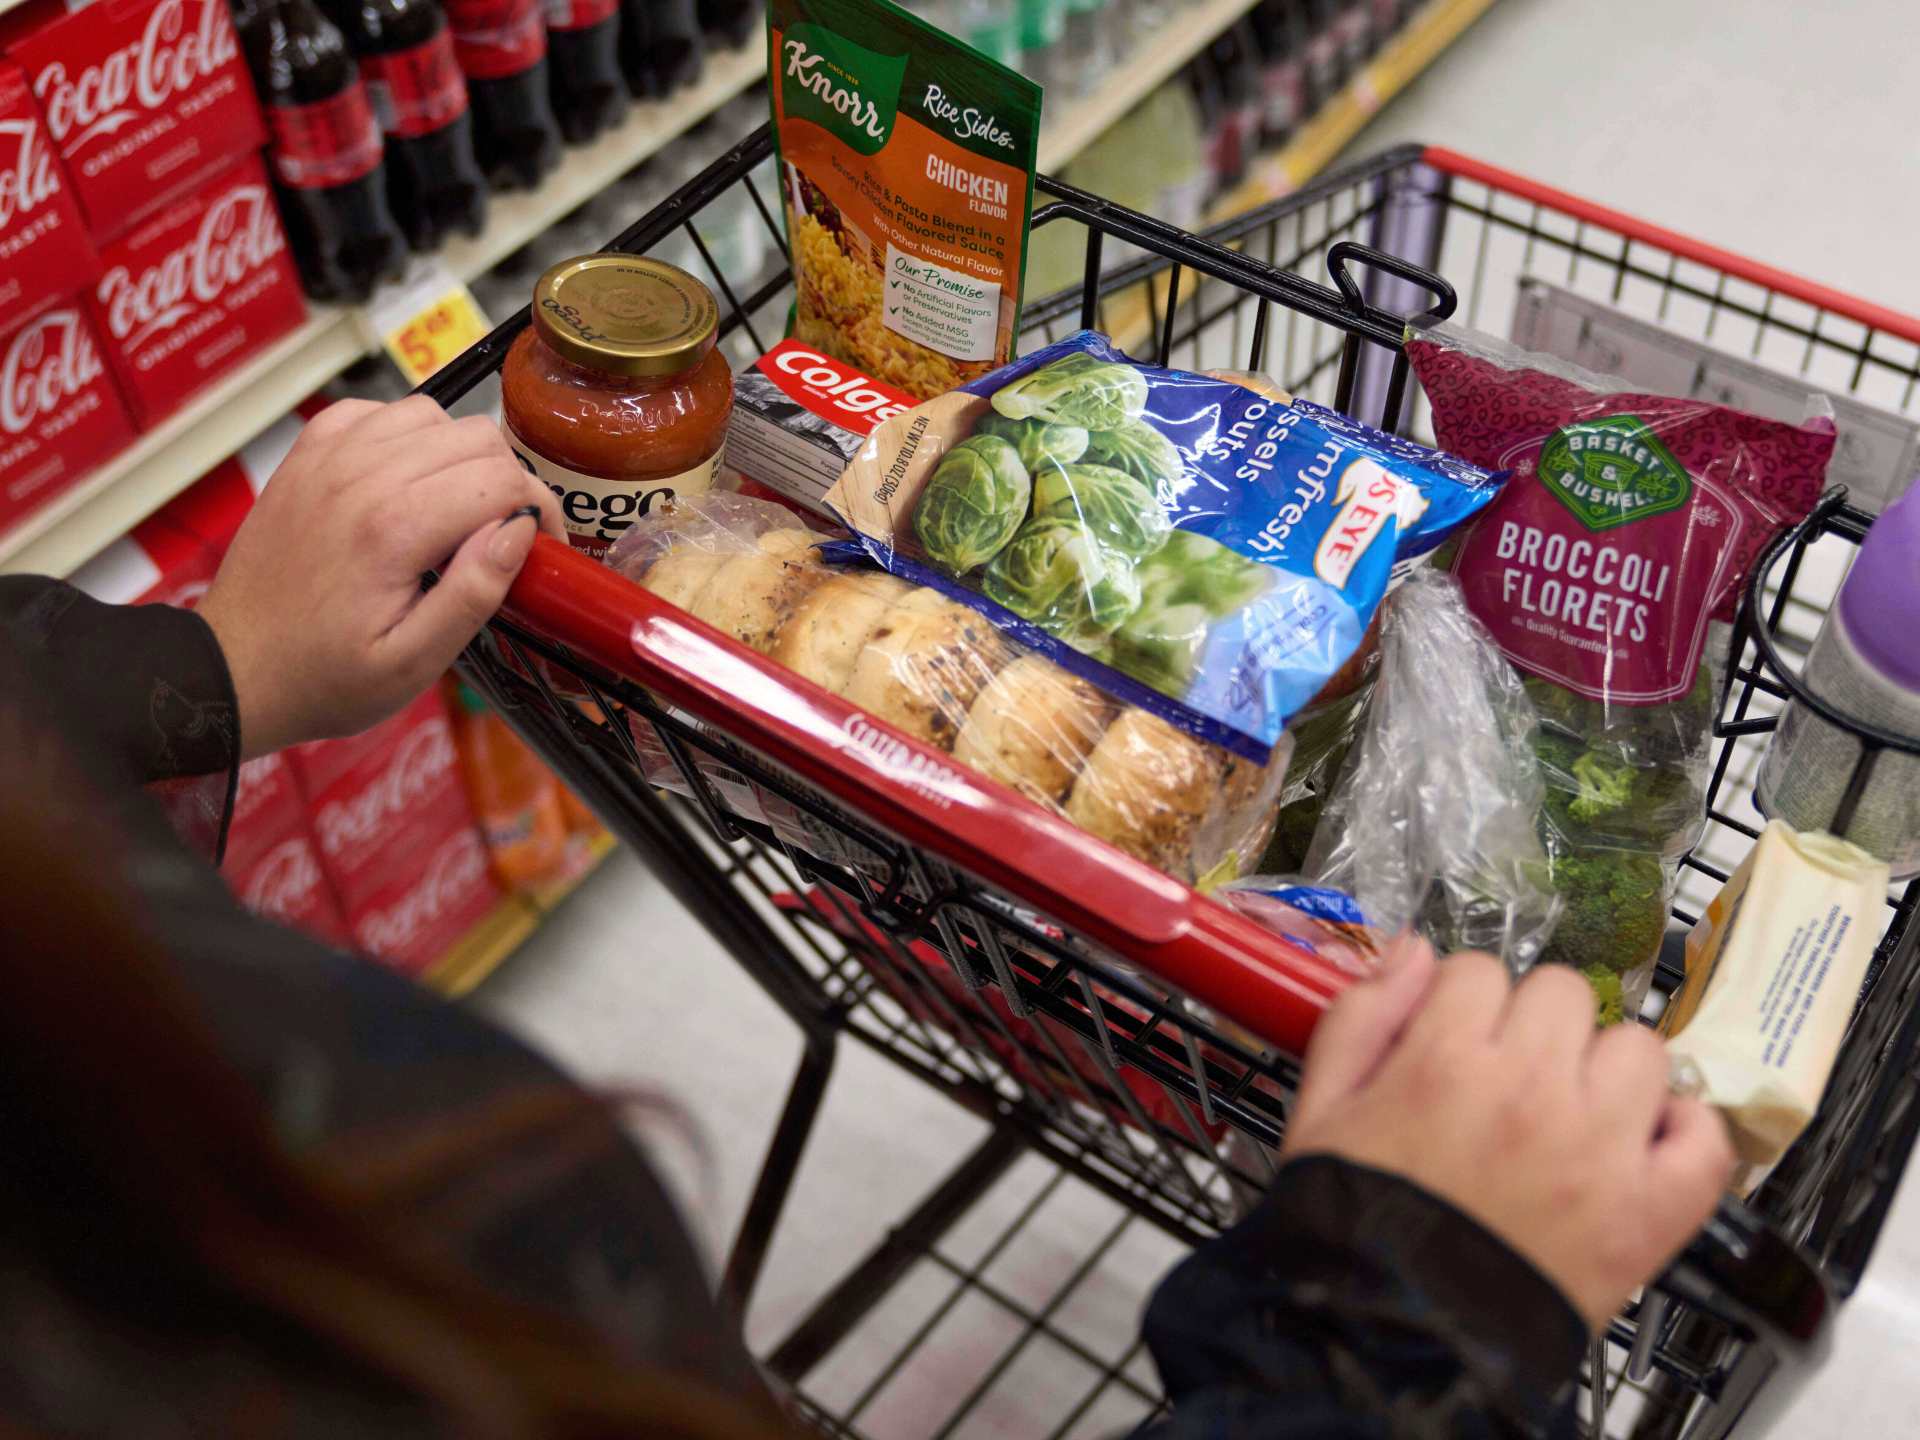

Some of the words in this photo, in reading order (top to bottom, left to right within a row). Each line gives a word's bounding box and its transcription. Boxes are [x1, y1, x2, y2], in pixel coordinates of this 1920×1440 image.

[785, 40, 885, 137] Knorr
[922, 84, 960, 124] Rice
[926, 153, 1009, 206] CHICKEN
[864, 170, 882, 192] Rice
[883, 188, 892, 202] &
[894, 195, 929, 222] Pasta
[932, 215, 976, 236] Blend
[979, 226, 993, 242] in
[996, 237, 1006, 246] a
[969, 200, 1009, 221] FLAVOR
[873, 214, 890, 235] With
[891, 228, 919, 250] Other
[921, 243, 965, 266] Natural
[967, 258, 1004, 277] Flavor
[896, 211, 957, 246] Flavored
[960, 236, 1005, 260] Sauce
[895, 257, 920, 276] Our
[922, 268, 985, 299] Promise
[542, 298, 608, 342] Prego
[903, 282, 916, 294] No
[917, 289, 954, 309] Artificial
[956, 303, 992, 318] Flavors
[903, 294, 912, 302] or
[913, 296, 973, 325] Preservatives
[902, 306, 915, 318] No
[916, 312, 945, 331] Added
[946, 324, 969, 339] MSG
[904, 432, 922, 450] WT
[912, 415, 931, 435] NET
[1206, 397, 1273, 461] outs
[896, 446, 915, 467] 10.8
[1235, 408, 1309, 483] ssels
[1568, 435, 1661, 470] BASKET
[873, 474, 900, 505] (306g)
[889, 464, 906, 479] OZ
[1559, 472, 1647, 508] BUSHEL
[1601, 465, 1617, 481] &
[1247, 440, 1345, 552] mfresh
[1327, 504, 1379, 562] EYE
[1496, 520, 1670, 603] BROCCOLI
[1502, 567, 1649, 643] FLORETS
[1526, 618, 1558, 640] Quality
